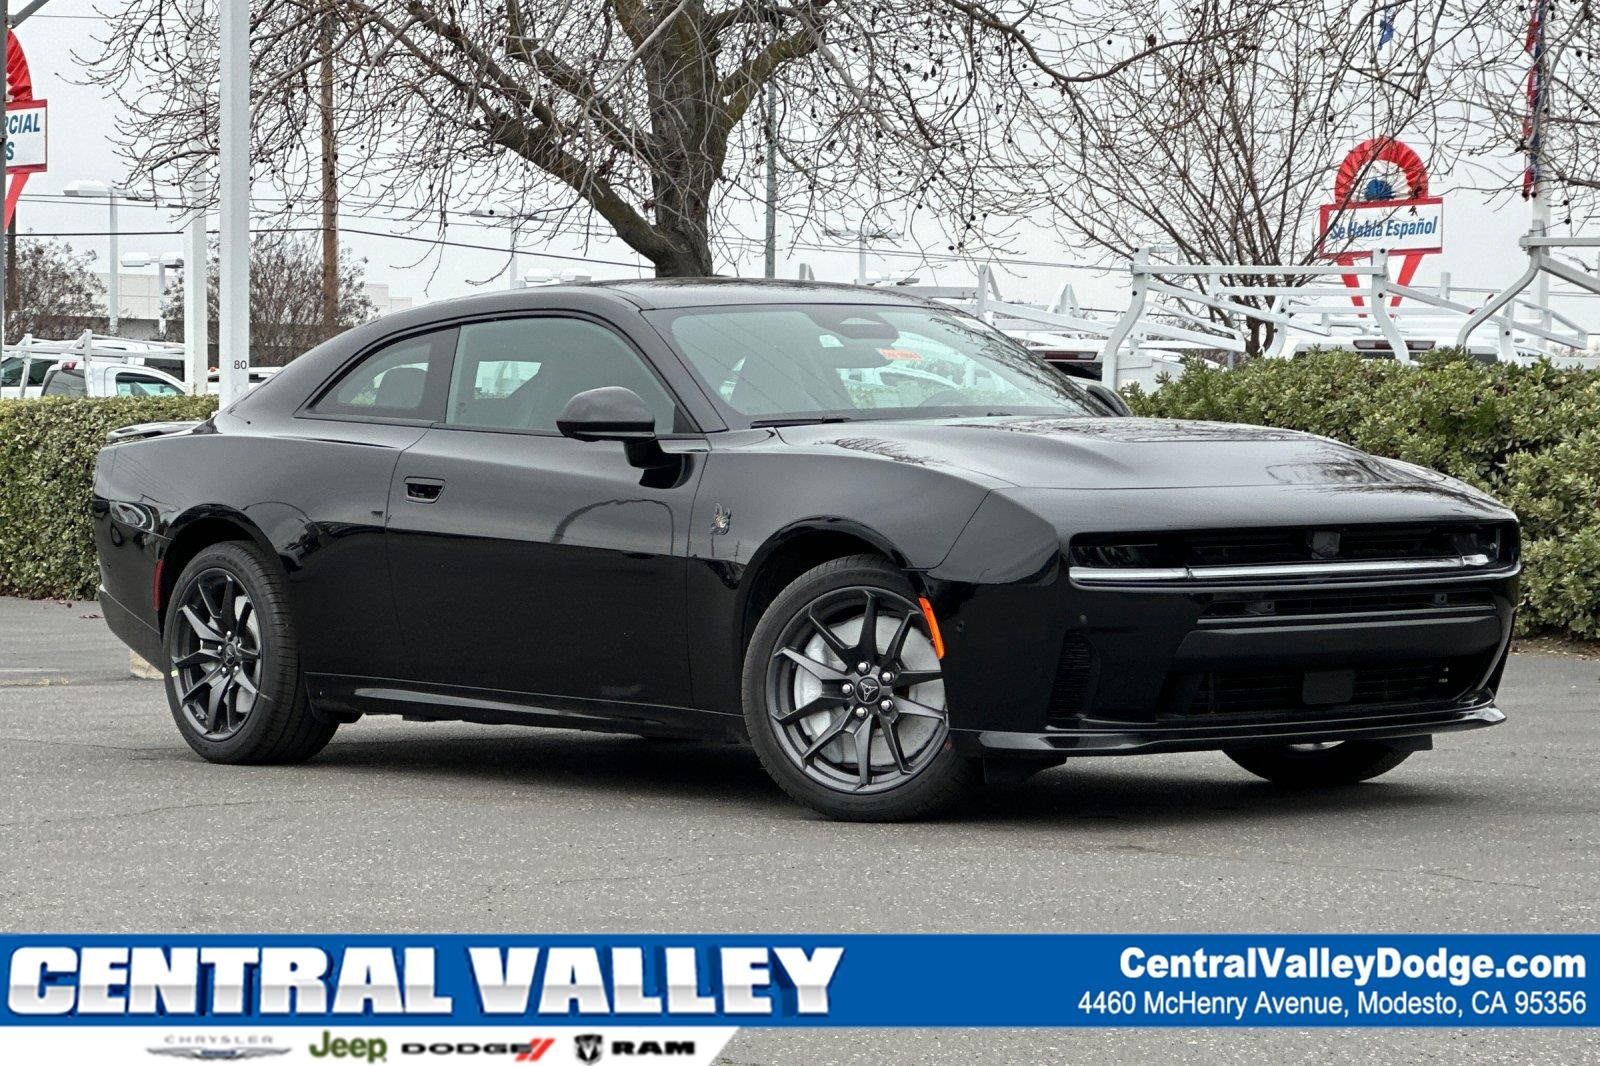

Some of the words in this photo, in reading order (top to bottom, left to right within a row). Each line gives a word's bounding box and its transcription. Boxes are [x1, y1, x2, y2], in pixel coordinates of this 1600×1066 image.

[1331, 224, 1345, 239] Se
[1348, 218, 1383, 237] Habla
[1386, 216, 1438, 239] Español
[234, 360, 247, 370] 80
